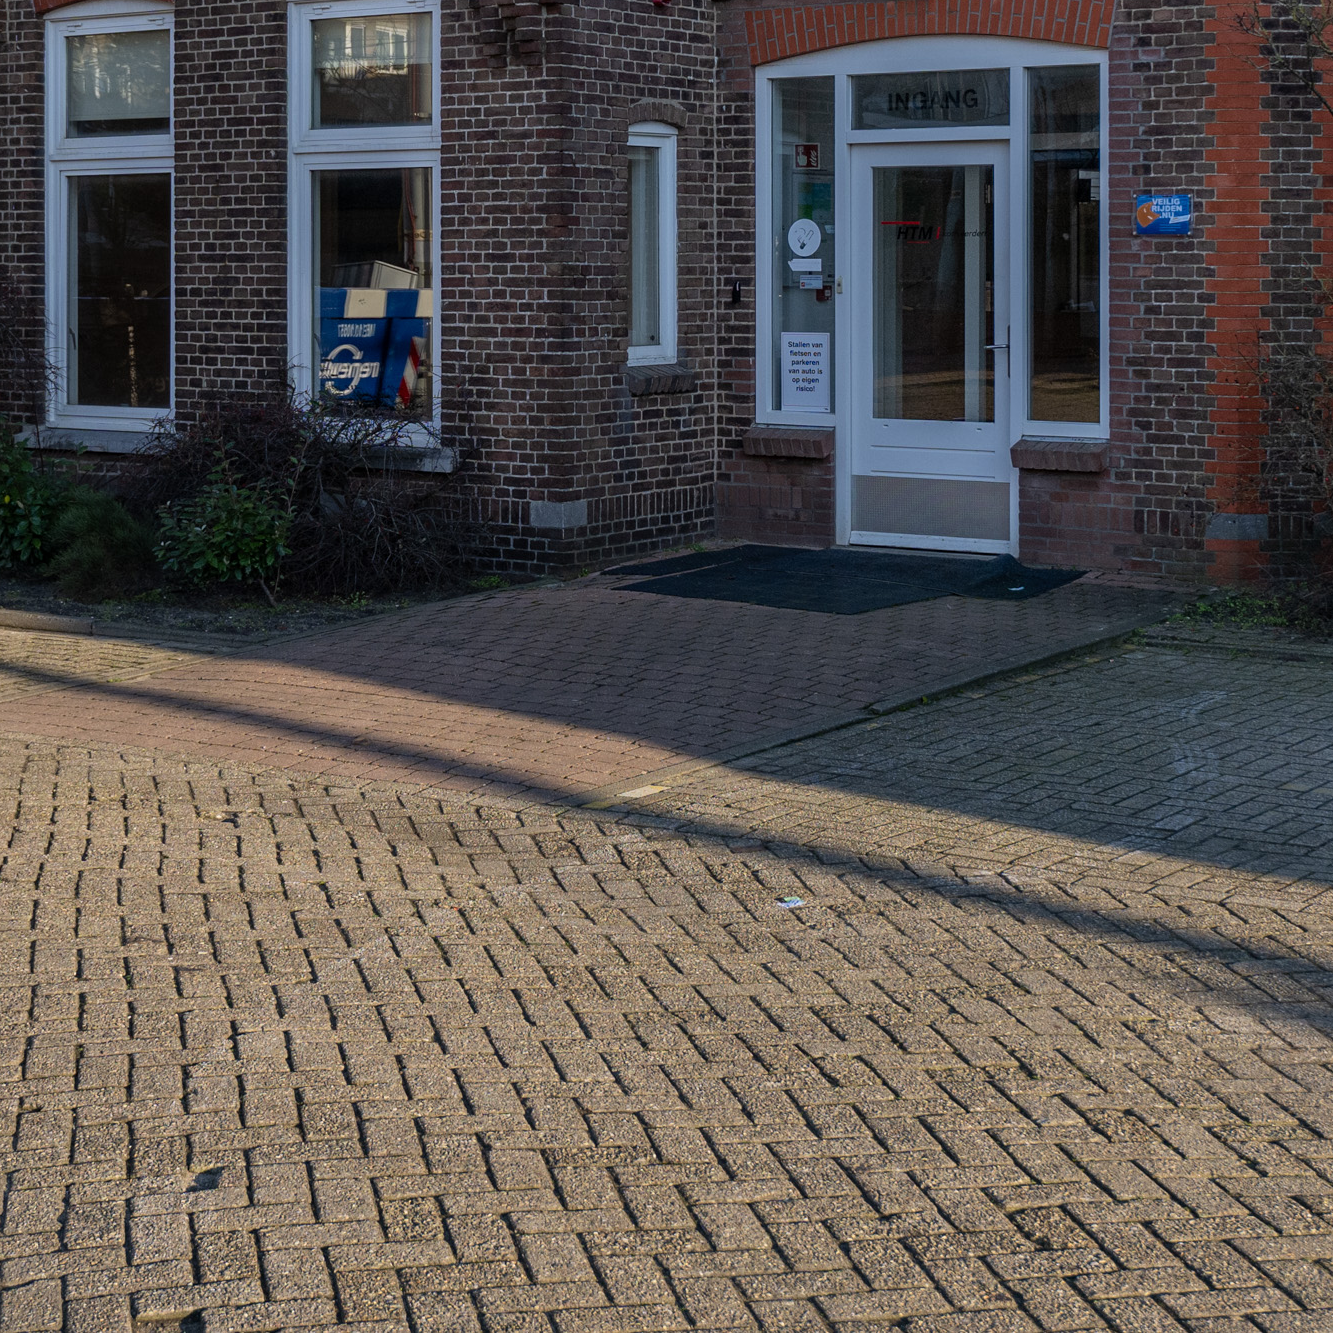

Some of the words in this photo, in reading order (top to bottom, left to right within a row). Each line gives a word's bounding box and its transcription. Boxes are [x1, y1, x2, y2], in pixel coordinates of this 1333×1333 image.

[888, 89, 978, 111] INGANG
[897, 226, 933, 240] HTM
[802, 376, 819, 384] eigen
